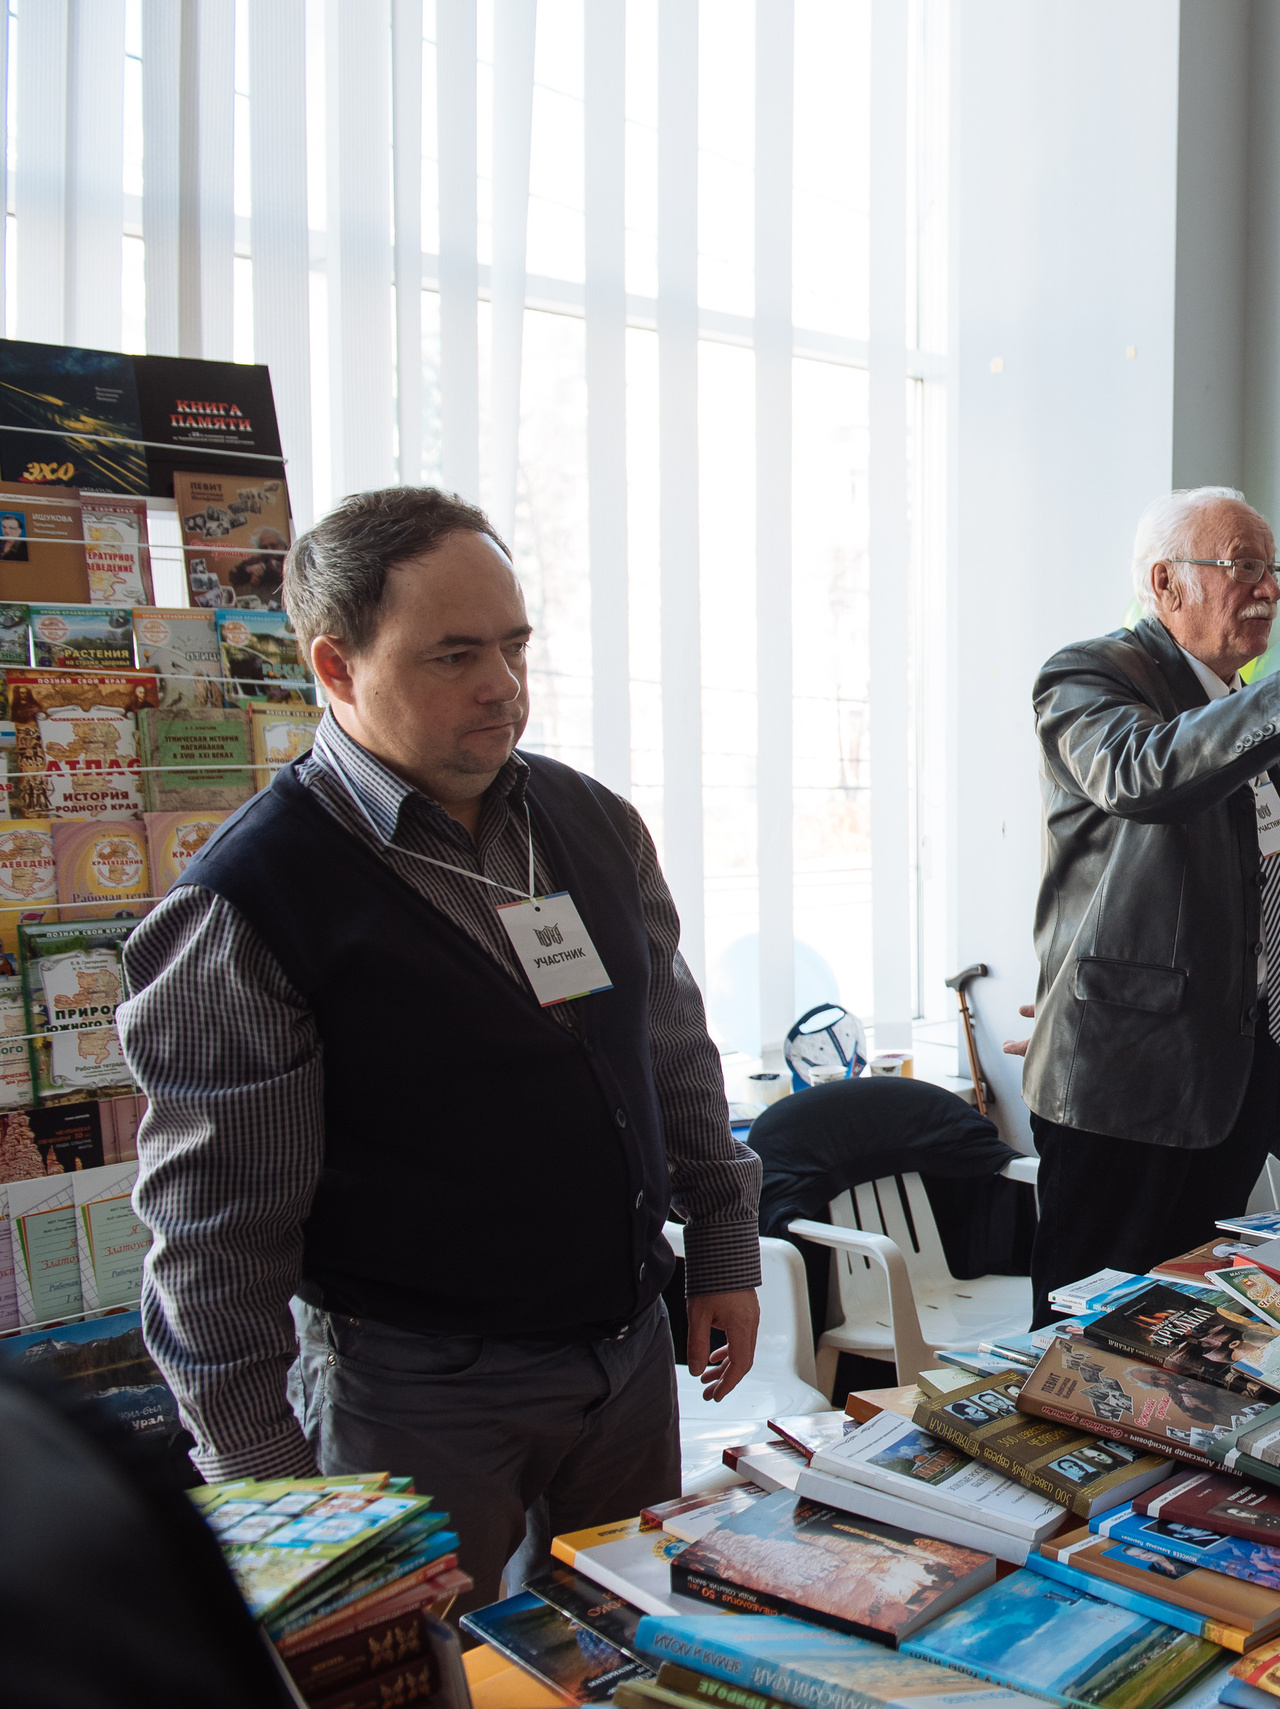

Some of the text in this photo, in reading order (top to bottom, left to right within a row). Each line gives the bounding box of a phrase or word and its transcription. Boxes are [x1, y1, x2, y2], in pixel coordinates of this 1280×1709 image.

[176, 400, 243, 417] КНИГА
[169, 413, 253, 433] ПАМЯТИ
[22, 461, 75, 481] ЭХО
[32, 513, 73, 523] ИШУКОВА
[64, 649, 129, 659] РАСТЕНИЯ
[44, 758, 142, 778] АТЛАС
[62, 791, 130, 802] ИСТОРИЯ
[55, 802, 139, 813] РОДНОГО КРАЯ
[91, 858, 144, 866] КРАЕВЕДЕНИЕ
[46, 926, 128, 939] ПОЗНАЙ СВОЙ КРАЙ
[533, 947, 587, 969] УЧАСТНИК
[1041, 1405, 1079, 1422] хроники
[929, 1417, 977, 1458] ЧЕЛЯБИНСКА
[1129, 1433, 1173, 1452] Иосифович
[973, 1447, 1010, 1471] евреев
[1169, 1446, 1216, 1468] Александр
[1008, 1463, 1053, 1497] известных
[1050, 1485, 1073, 1507] 300
[1172, 1548, 1198, 1564] МОИСЕЕВ
[701, 1586, 779, 1618] СПЕЛЕОЛОГИЯ 50
[653, 1632, 693, 1659] ЛЮДИ
[701, 1648, 743, 1675] ЗЕМЛЯ
[587, 1661, 637, 1688] МАТЕРИАЛЫ
[697, 1680, 767, 1709] ПРИРОДЕ
